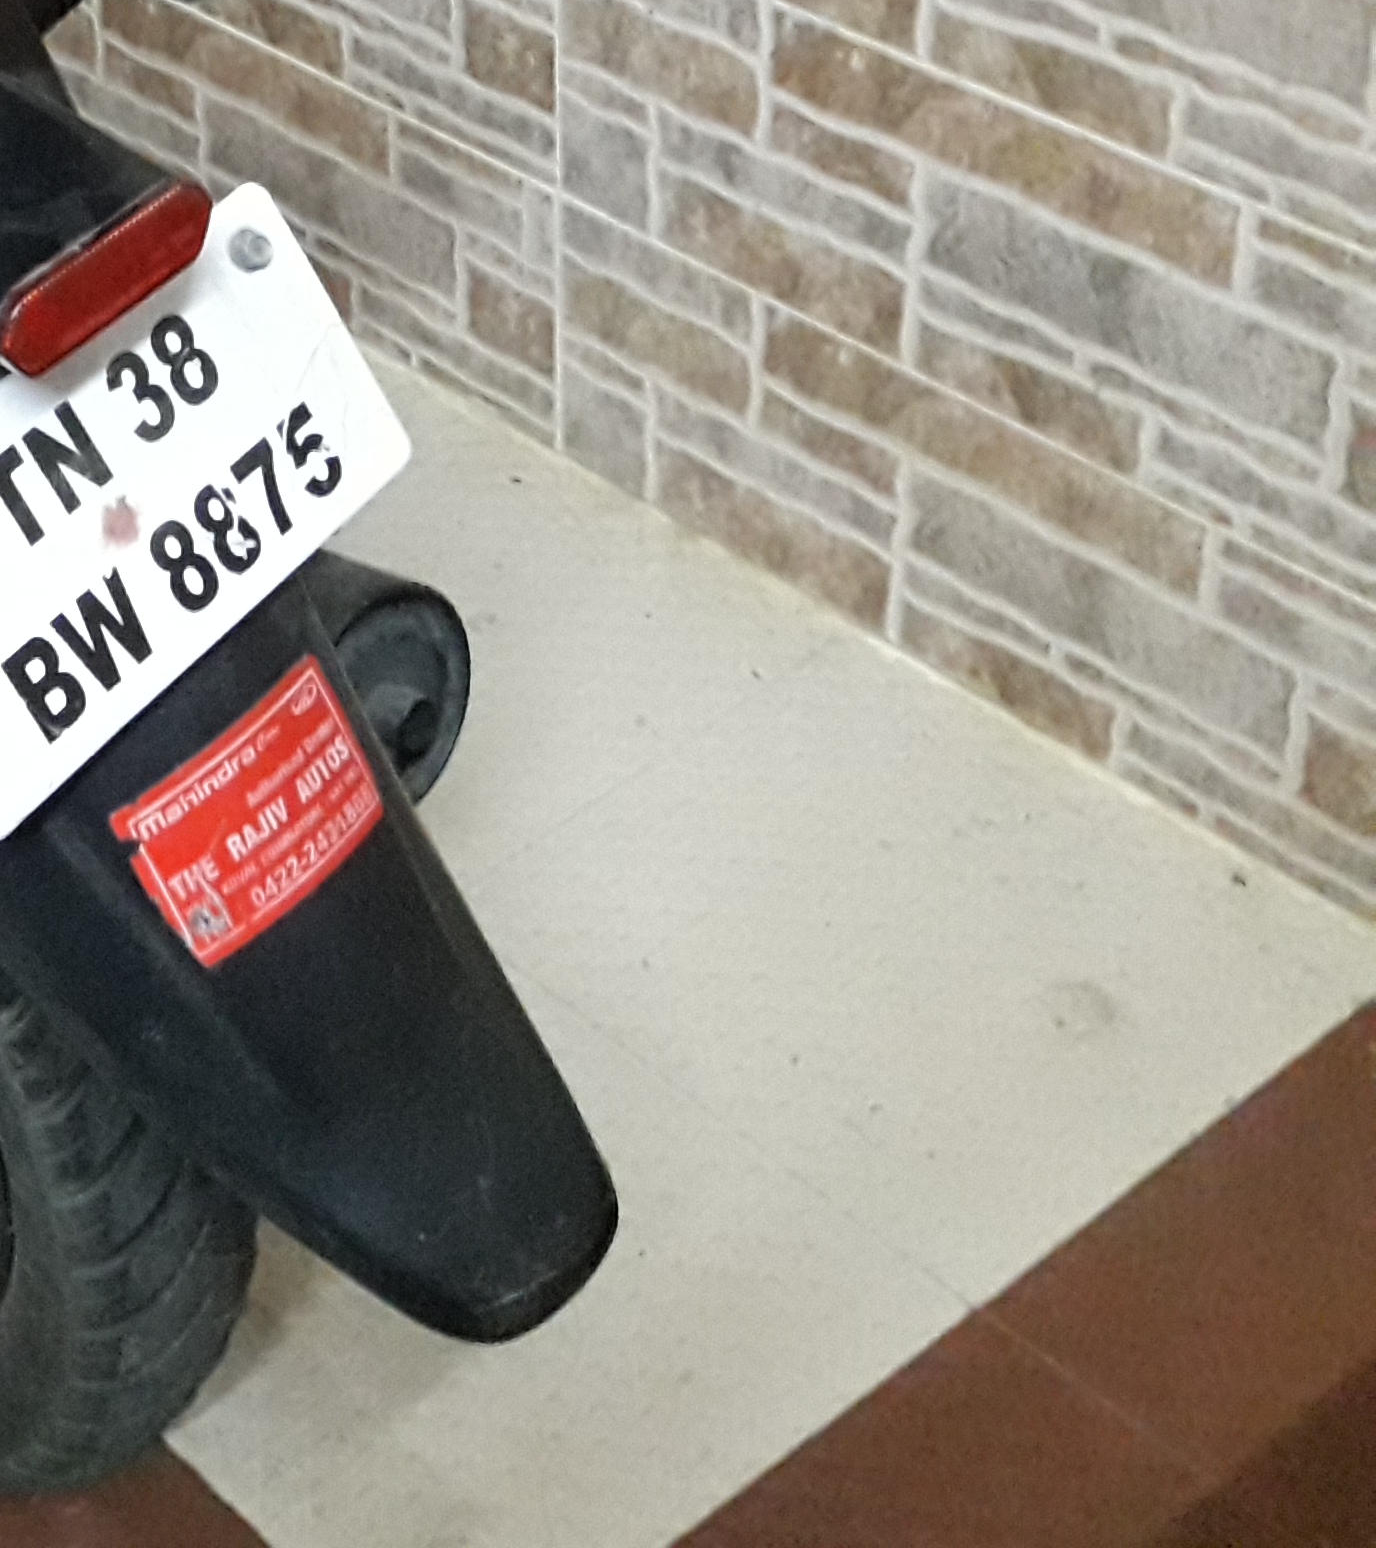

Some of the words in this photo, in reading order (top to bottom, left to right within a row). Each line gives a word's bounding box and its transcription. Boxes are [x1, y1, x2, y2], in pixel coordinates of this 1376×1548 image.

[106, 315, 218, 443] 38
[0, 566, 153, 745] BW
[149, 402, 342, 613] 8875
[168, 853, 220, 901] THE
[225, 796, 289, 862] RAJIV
[295, 734, 350, 804] AUTOS
